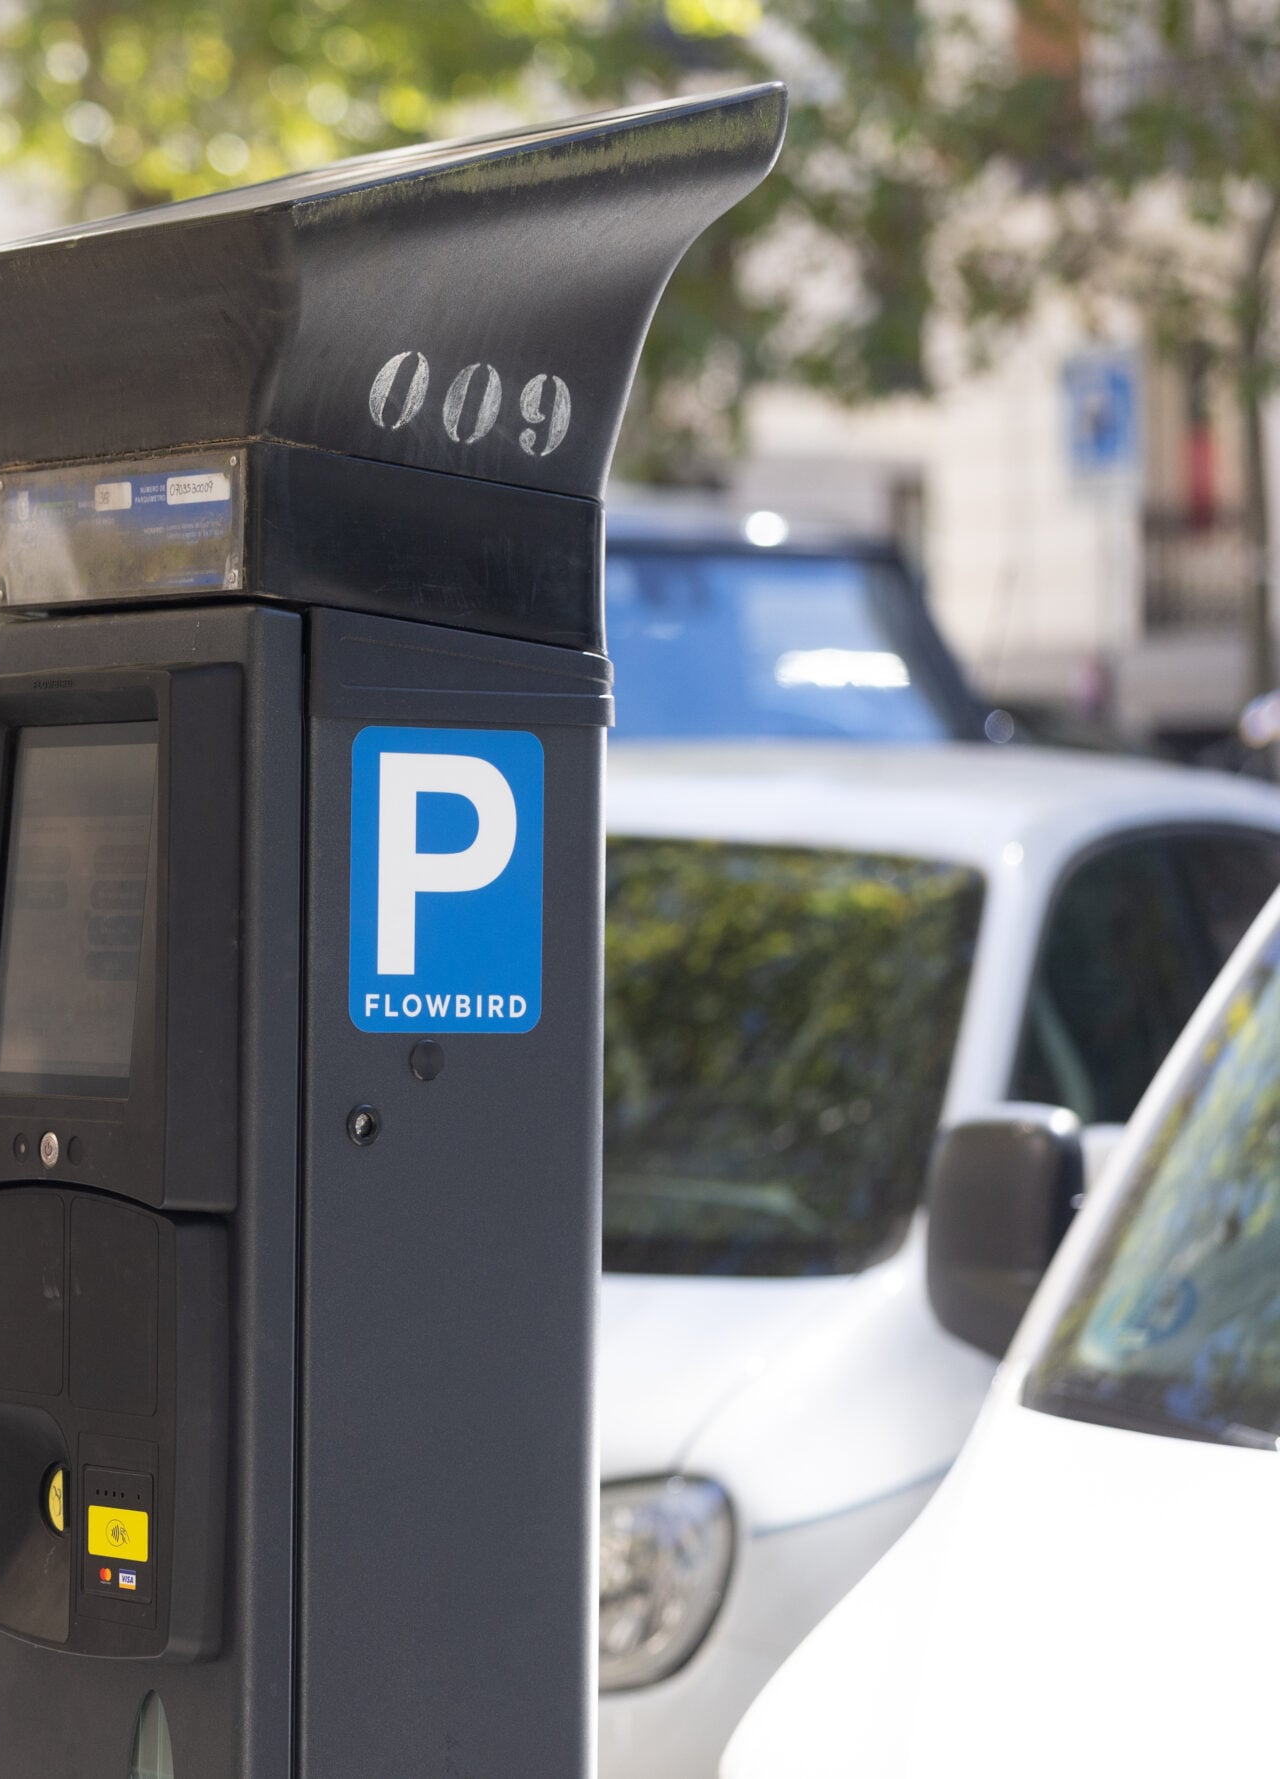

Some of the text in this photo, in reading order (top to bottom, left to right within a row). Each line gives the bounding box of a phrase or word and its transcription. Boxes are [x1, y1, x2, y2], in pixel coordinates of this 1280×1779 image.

[369, 351, 571, 456] 009
[377, 752, 517, 976] P
[364, 993, 528, 1019] FLOWBIRD
[121, 1575, 134, 1584] VISA
